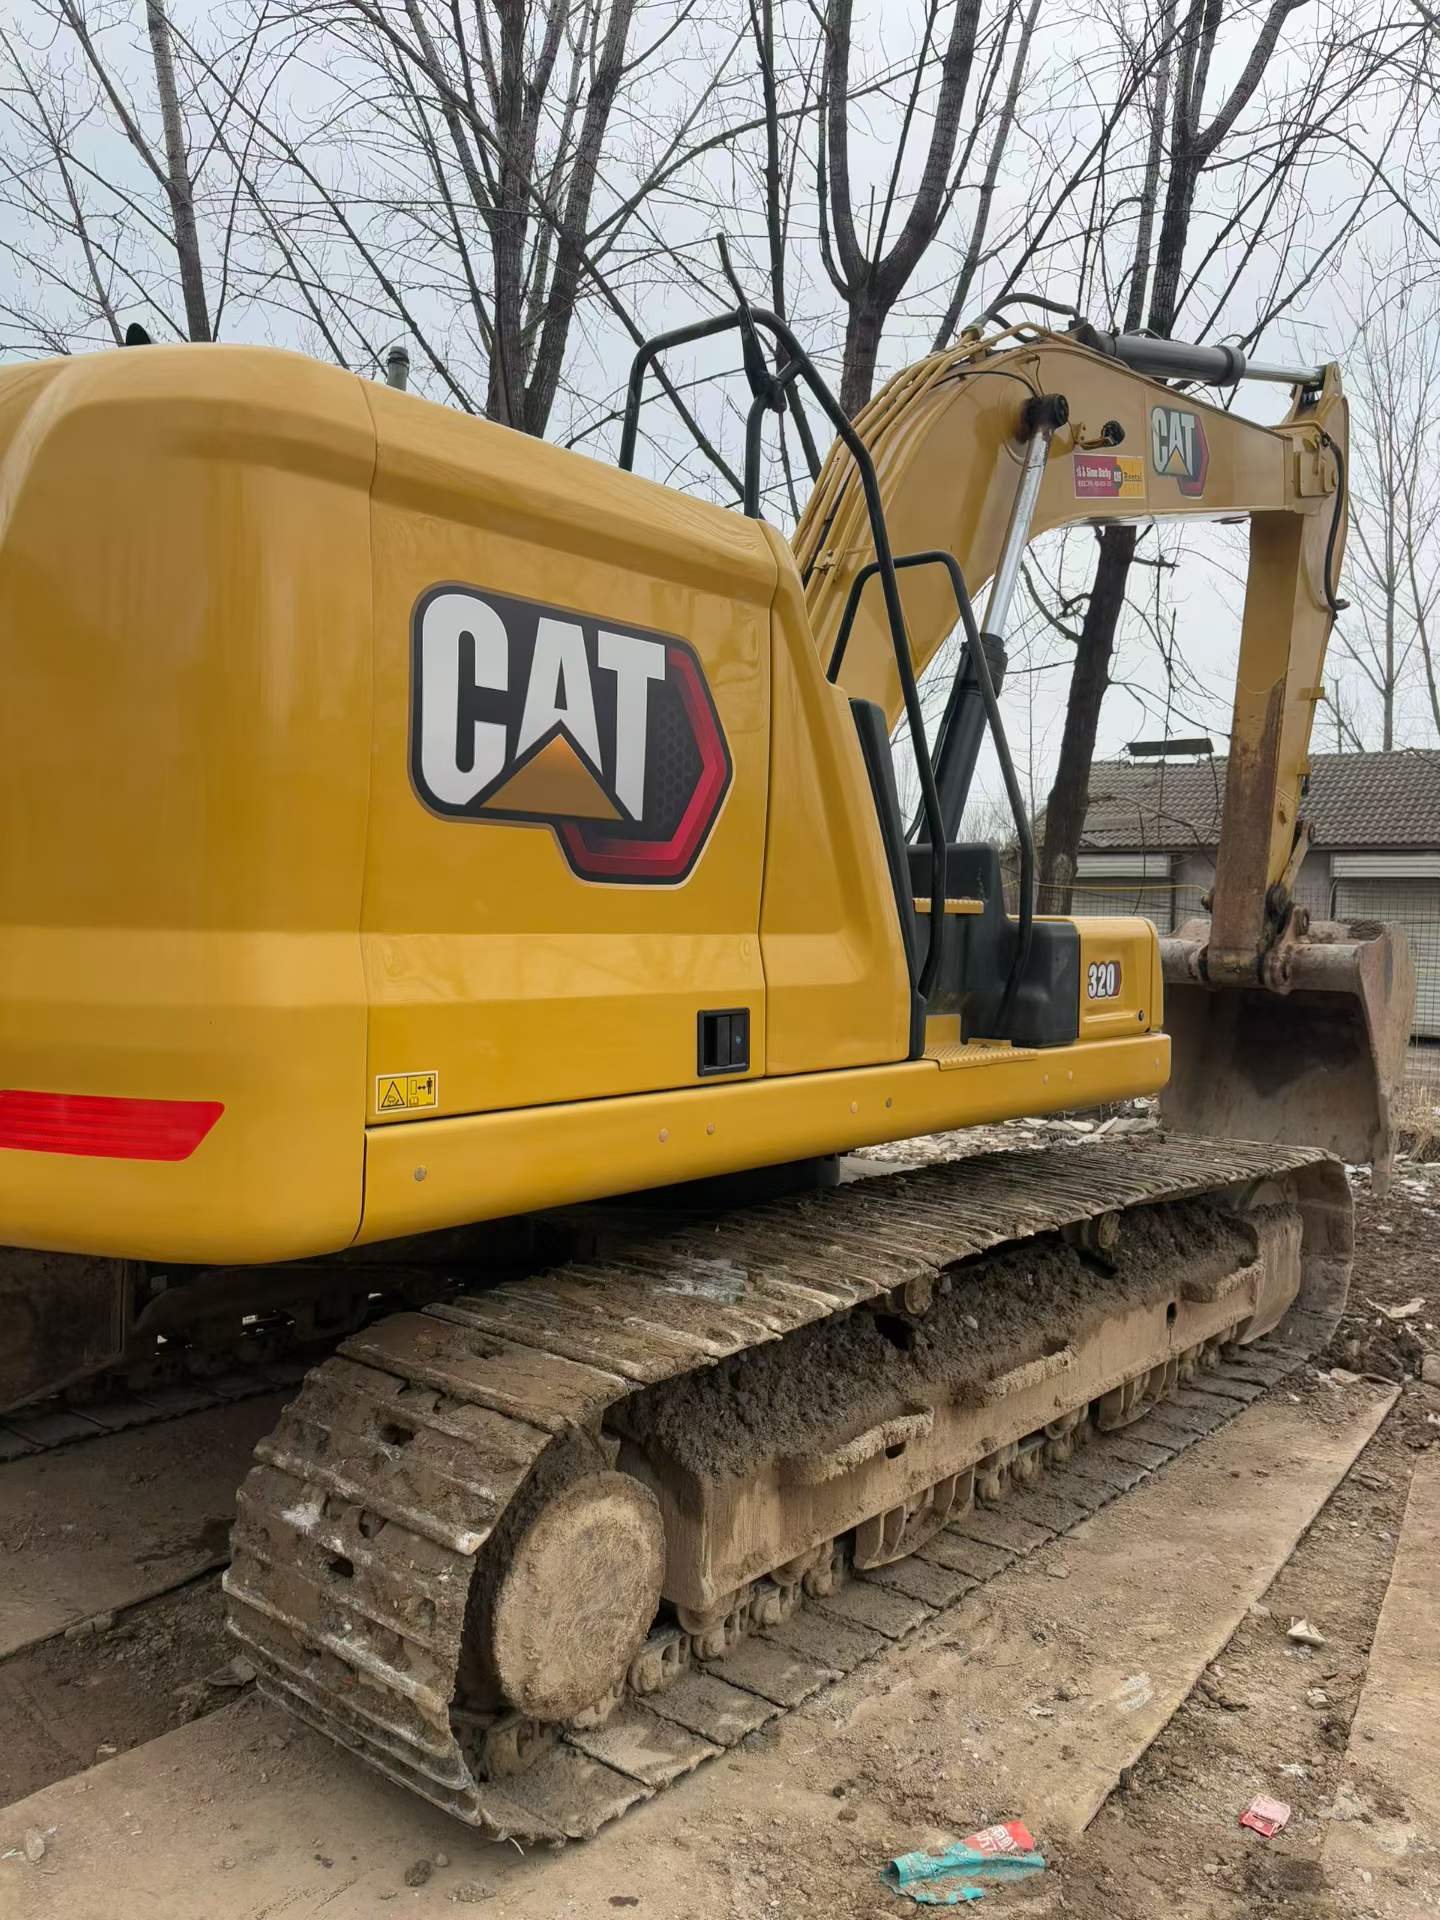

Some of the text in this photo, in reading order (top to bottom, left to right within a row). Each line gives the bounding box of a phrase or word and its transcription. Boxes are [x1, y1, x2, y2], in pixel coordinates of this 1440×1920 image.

[1152, 407, 1195, 476] CAT
[421, 593, 666, 822] CAT
[1088, 963, 1115, 997] 320
